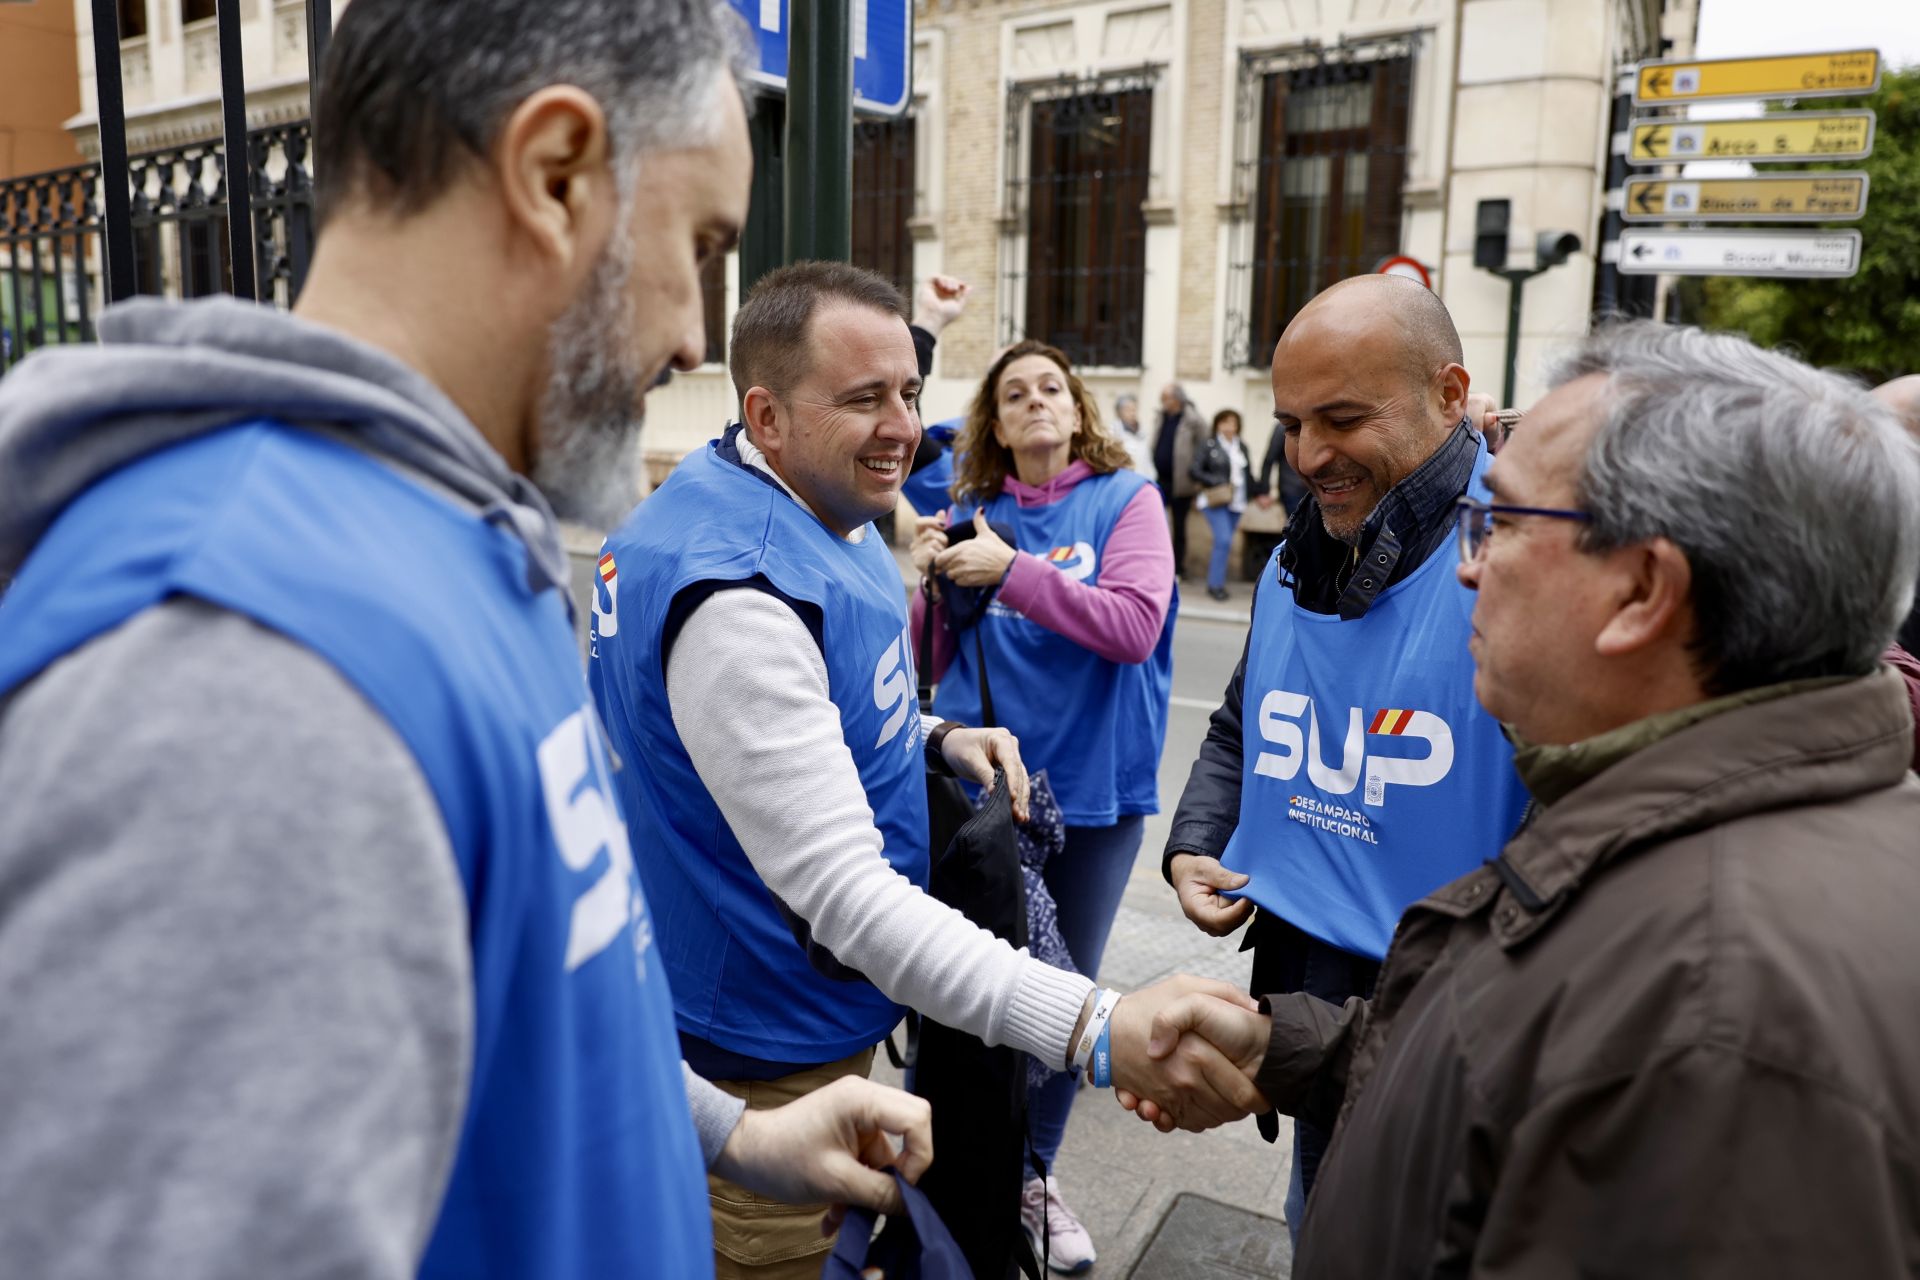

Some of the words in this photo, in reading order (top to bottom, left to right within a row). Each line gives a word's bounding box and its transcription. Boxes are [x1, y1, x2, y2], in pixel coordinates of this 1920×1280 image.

[1706, 135, 1758, 155] Arco
[1811, 133, 1859, 153] Juan
[1772, 195, 1793, 211] de
[1254, 689, 1454, 807] SUP
[1288, 808, 1378, 845] INSTITUCIONAL
[1294, 795, 1371, 828] DESAMPARO
